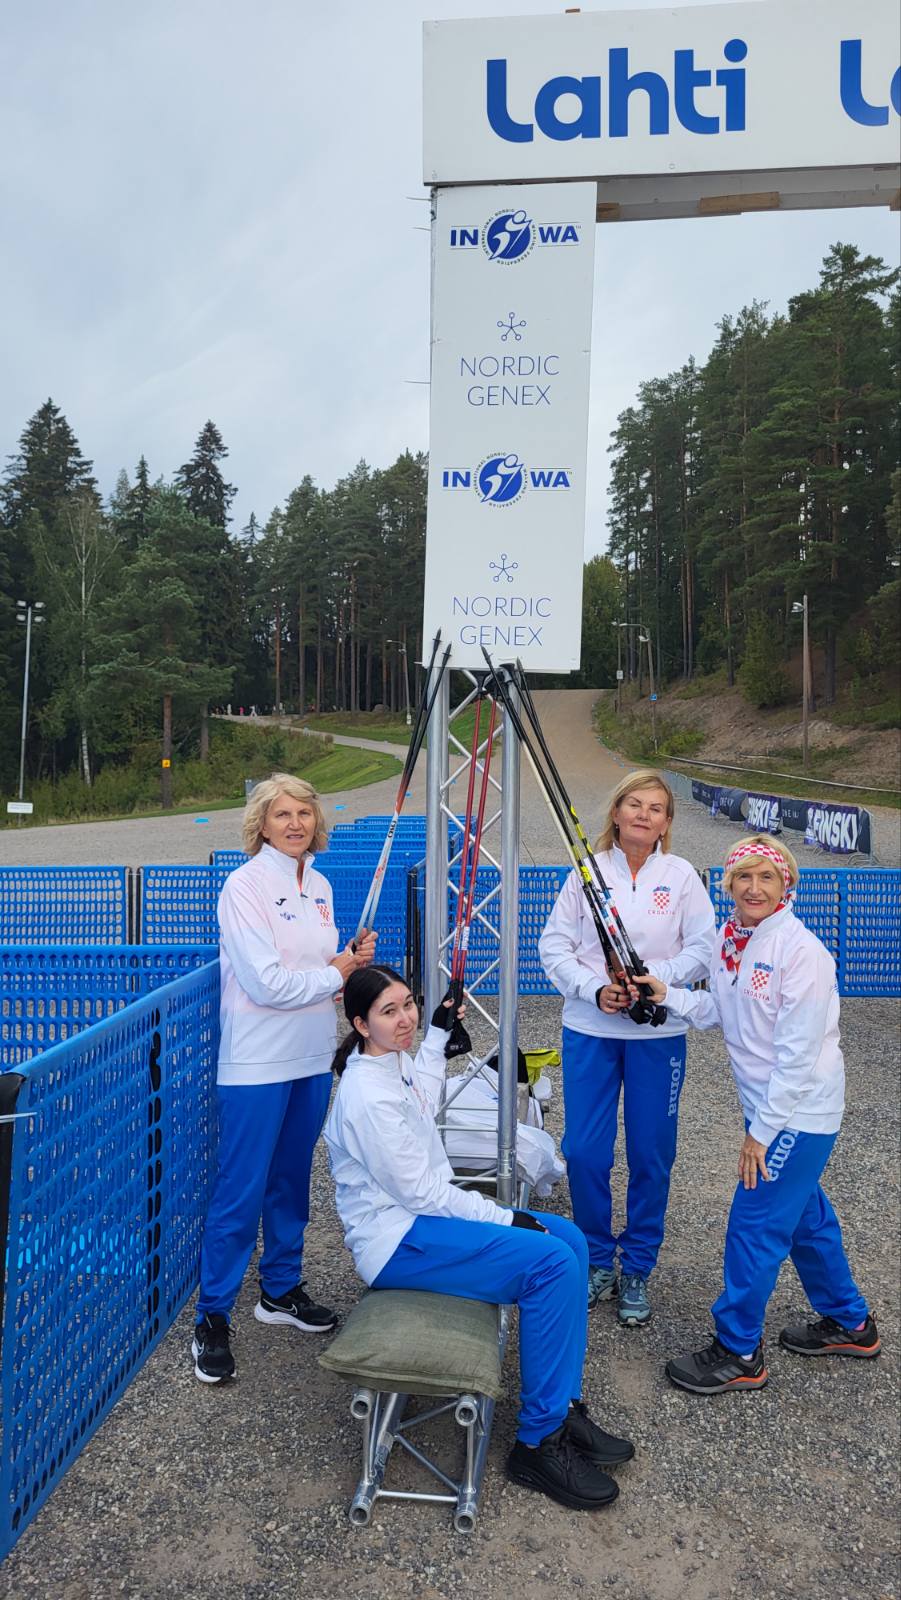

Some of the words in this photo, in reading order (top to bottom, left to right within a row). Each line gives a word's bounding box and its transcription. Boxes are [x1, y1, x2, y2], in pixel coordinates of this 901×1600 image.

[486, 38, 748, 143] Lahti
[840, 39, 901, 127] L
[450, 229, 479, 246] IN
[460, 355, 560, 377] NORDIC
[467, 385, 551, 406] GENEX
[442, 471, 471, 487] IN
[453, 596, 552, 617] NORDIC
[460, 625, 543, 647] GENEX
[813, 808, 858, 851] FINSKI
